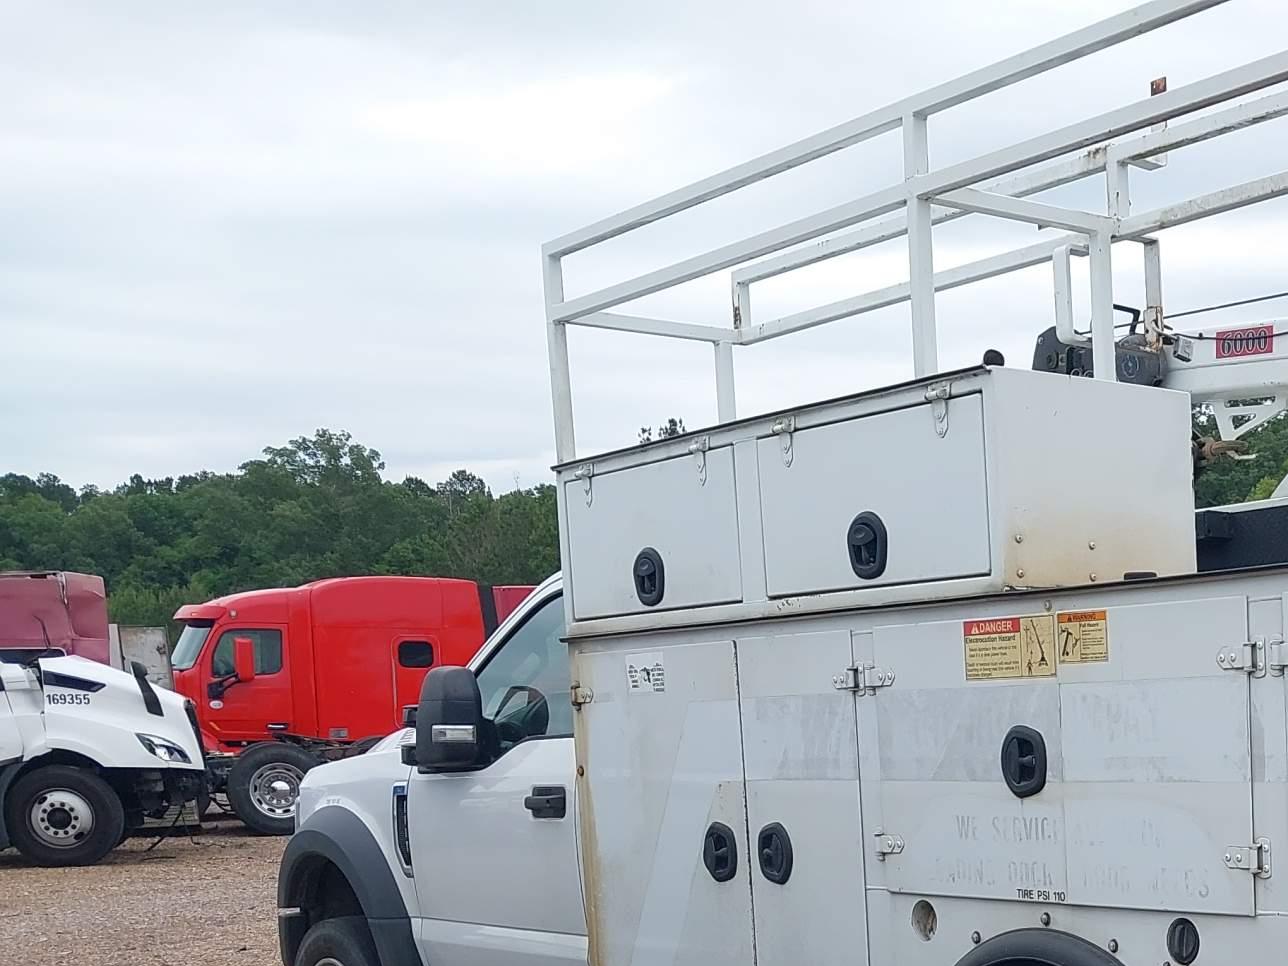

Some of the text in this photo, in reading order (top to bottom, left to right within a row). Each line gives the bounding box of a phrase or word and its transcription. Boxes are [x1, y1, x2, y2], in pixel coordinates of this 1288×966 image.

[1220, 328, 1268, 356] 6000
[980, 621, 1014, 633] DANGER
[46, 693, 91, 705] 169355
[1016, 888, 1066, 902] TIRE PSI 110
